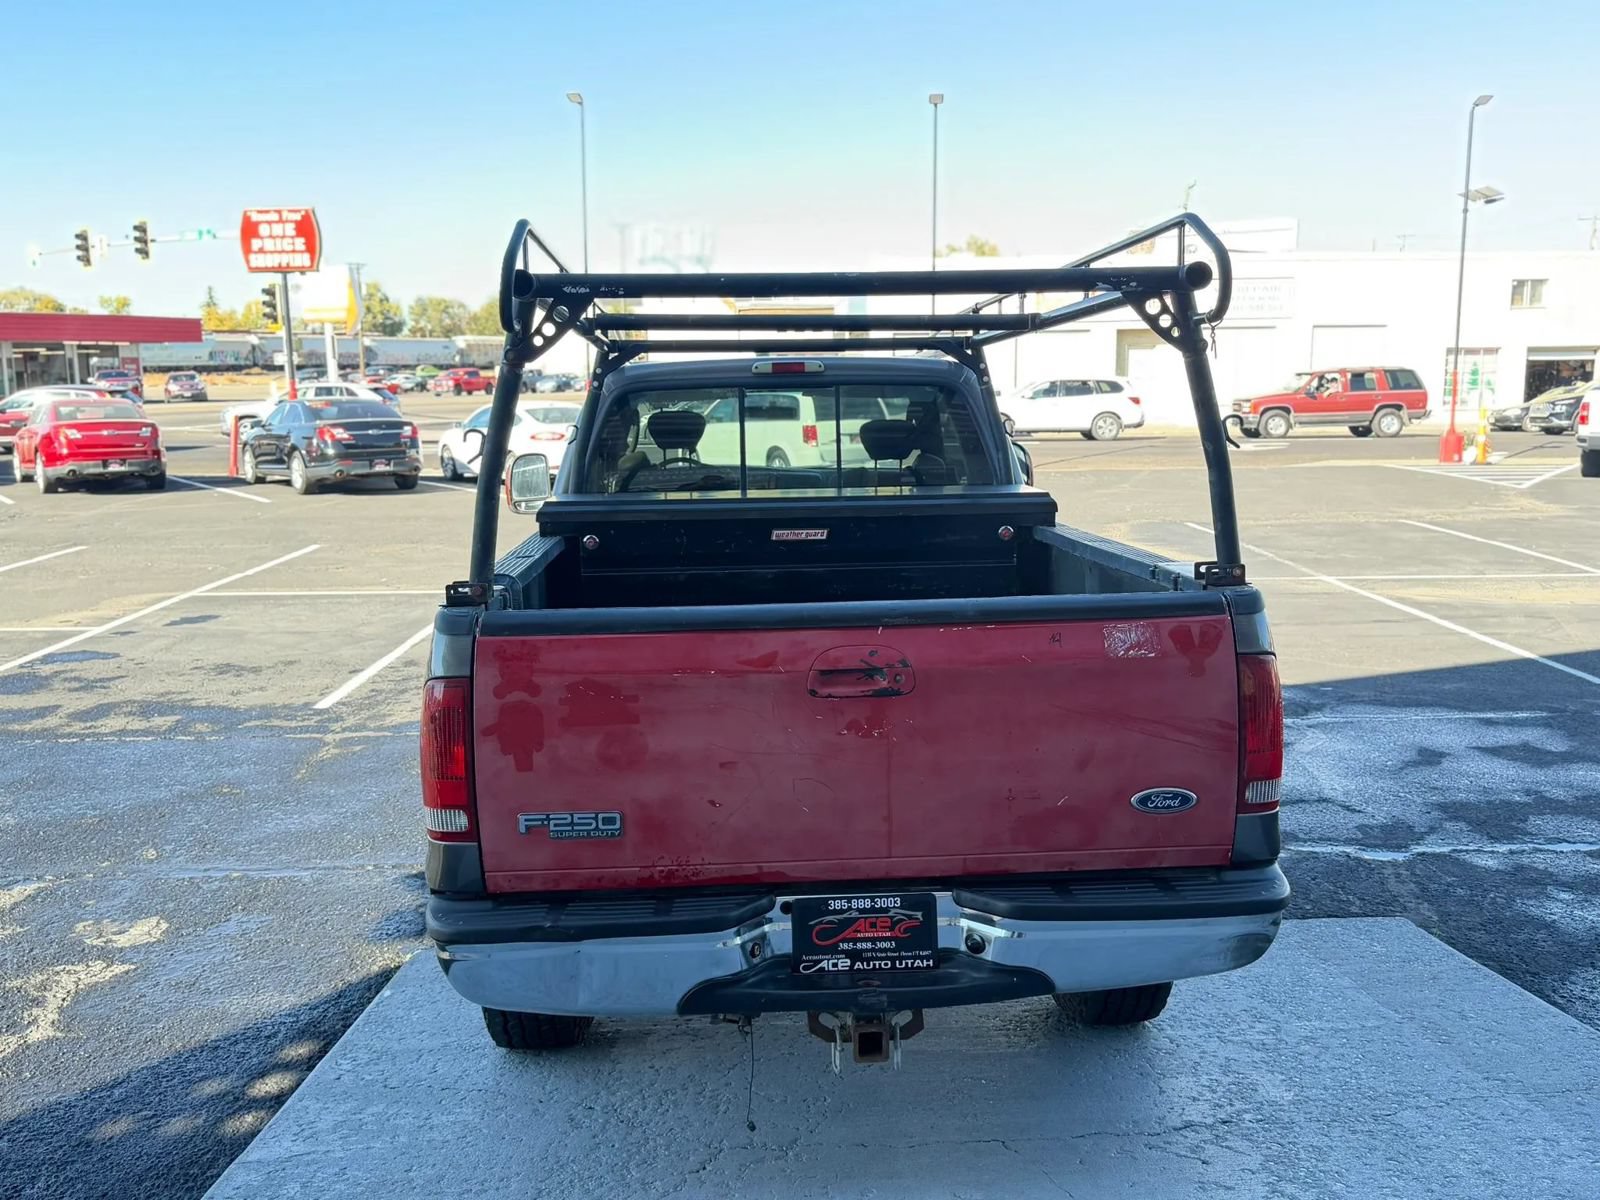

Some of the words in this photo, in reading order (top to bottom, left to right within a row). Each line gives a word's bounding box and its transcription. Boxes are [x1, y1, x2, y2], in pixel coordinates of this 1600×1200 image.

[258, 222, 297, 237] ONE
[251, 237, 306, 252] PRICE
[805, 531, 825, 539] guard
[1147, 793, 1182, 808] Ford
[590, 830, 621, 838] DUTY
[828, 897, 901, 910] 385-888-3003
[838, 941, 896, 951] 385-888-3003
[854, 961, 891, 970] AUTO
[896, 959, 934, 968] UTAH
